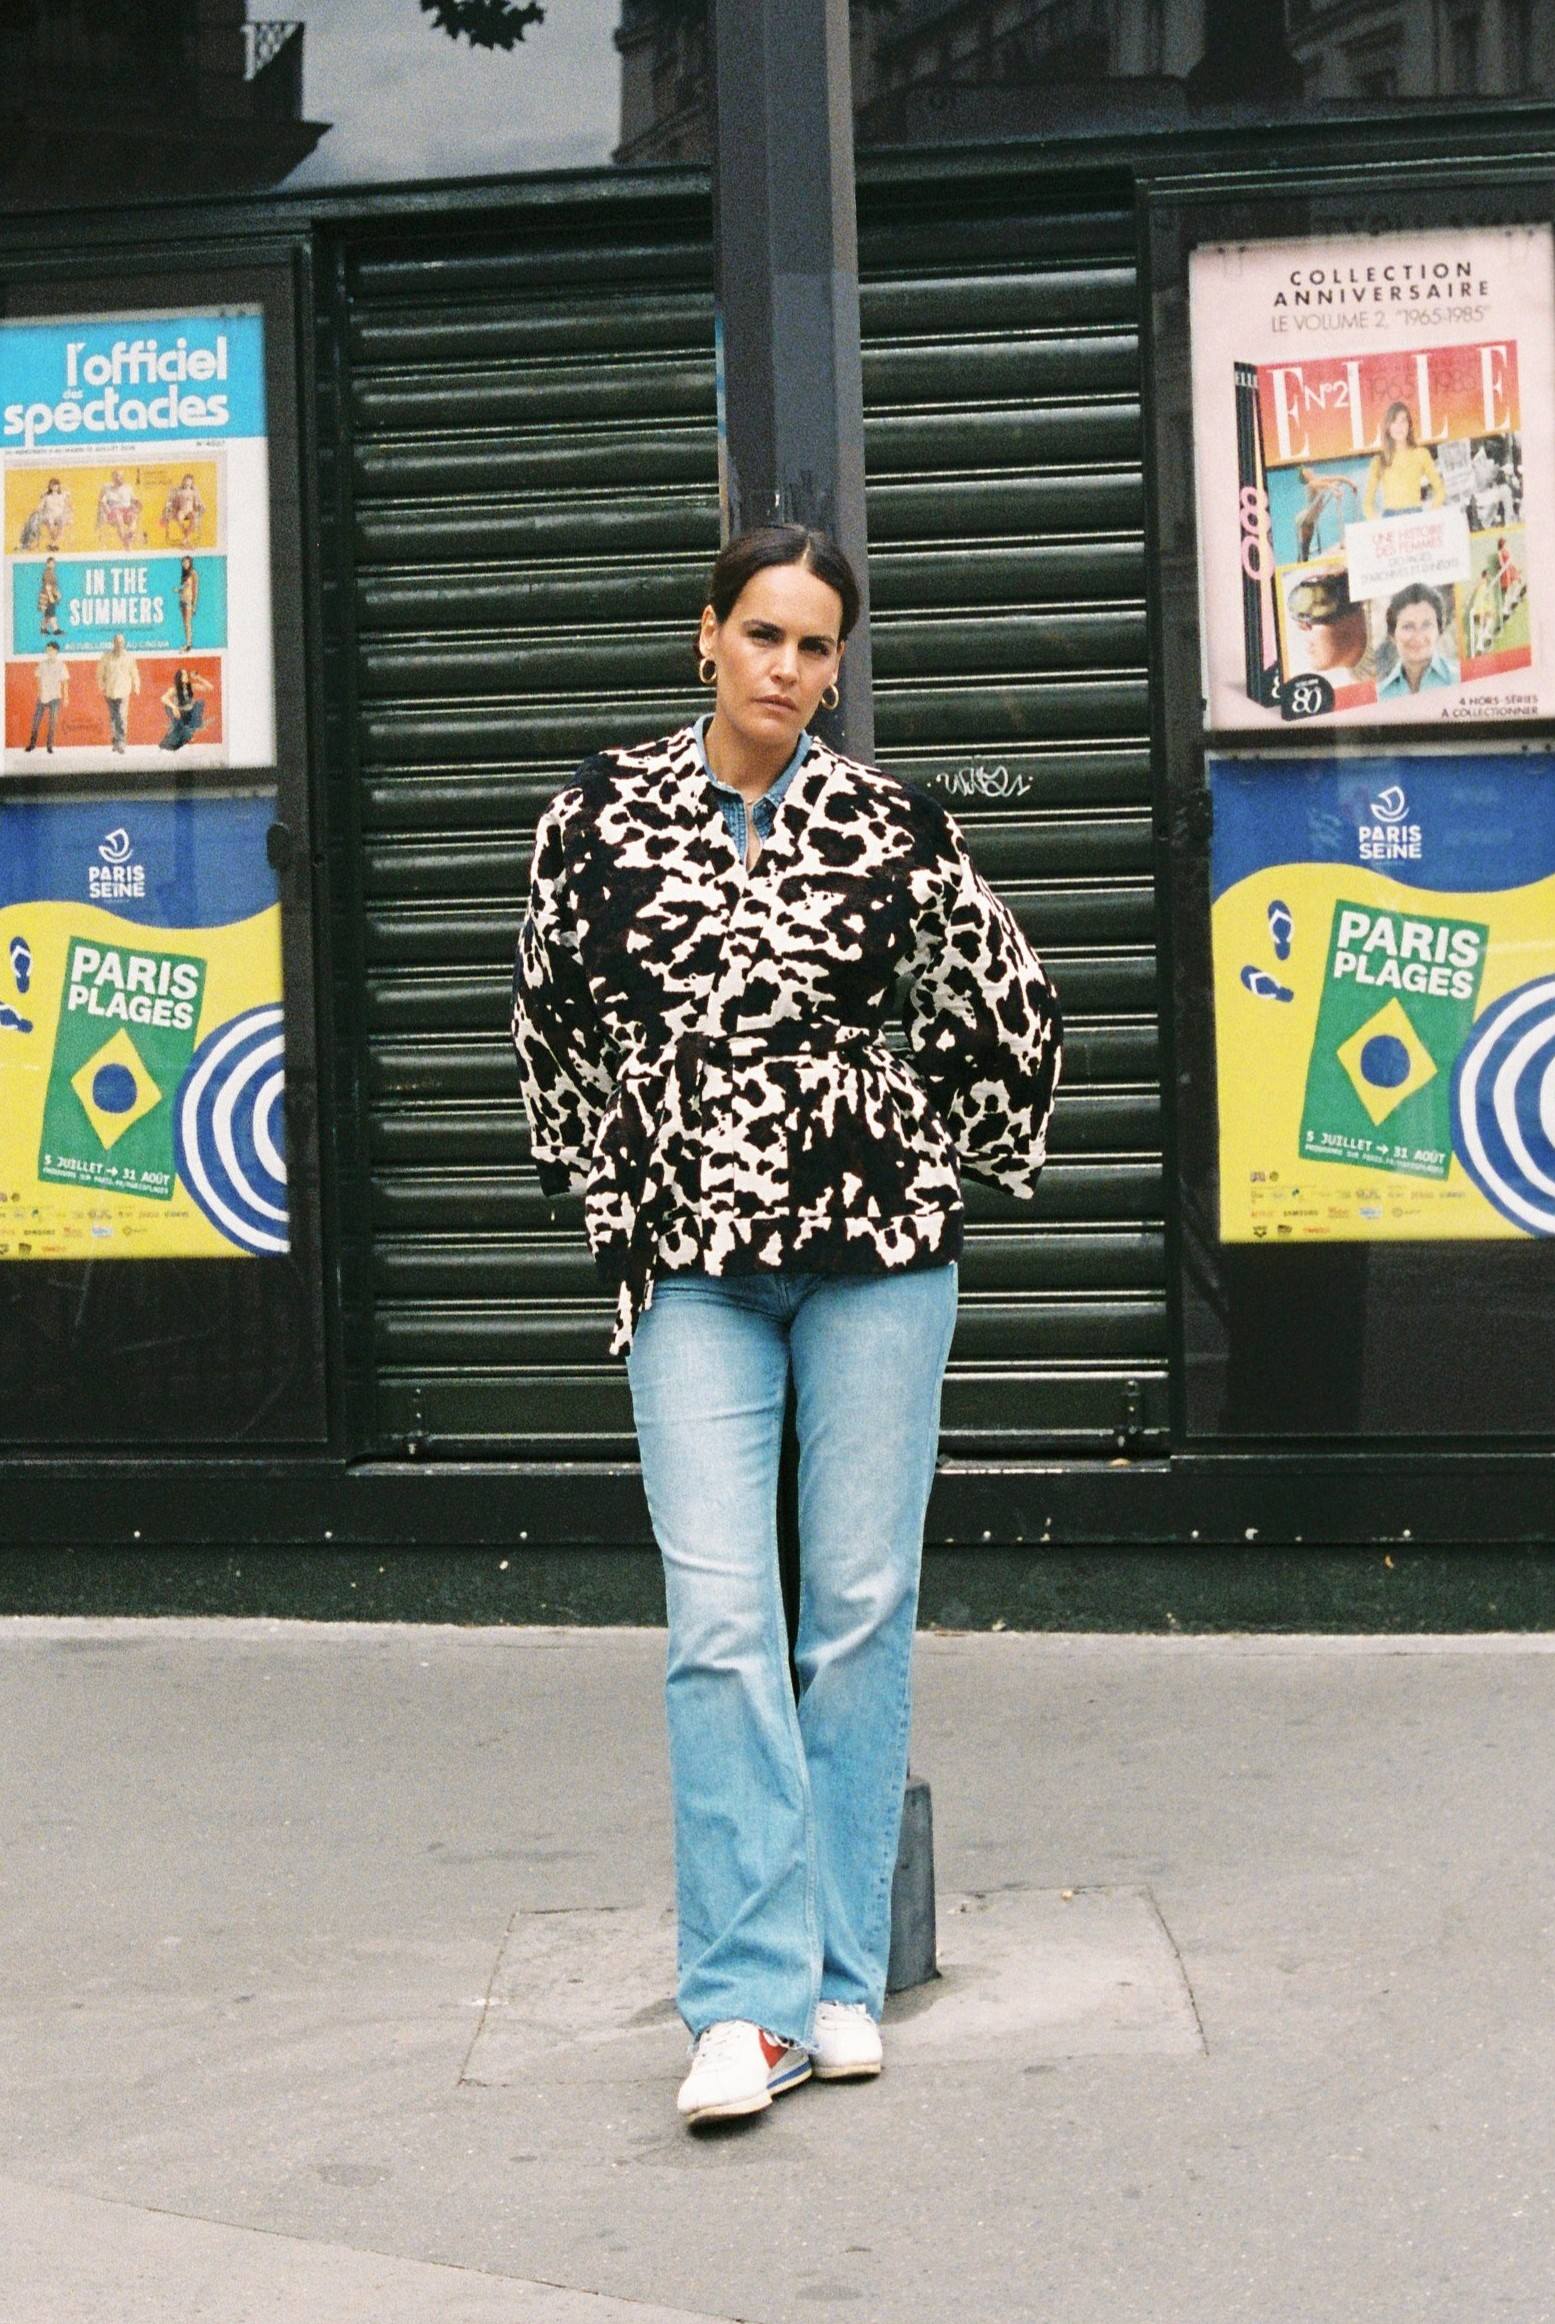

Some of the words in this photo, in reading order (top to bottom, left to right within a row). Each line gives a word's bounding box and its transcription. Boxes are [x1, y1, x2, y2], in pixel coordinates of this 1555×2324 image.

[1290, 262, 1471, 286] COLLECTION
[1274, 280, 1489, 307] ANNIVERSAIRE
[1272, 315, 1289, 333] LE
[1293, 311, 1369, 331] VOLUME
[66, 335, 228, 386] l'officiel
[4, 383, 229, 449] spectacles
[1266, 344, 1511, 460] ELLE
[86, 569, 105, 595] IN
[110, 567, 148, 595] THE
[70, 596, 164, 626] SUMMERS
[1292, 686, 1322, 714] 80
[1359, 824, 1422, 842] PARIS
[1359, 842, 1422, 859] SEINE
[88, 865, 145, 882] PARIS
[89, 882, 146, 899] SEINE
[1337, 910, 1480, 968] PARIS
[71, 946, 199, 1000] PARIS
[1333, 950, 1474, 999] PLAGES
[68, 984, 194, 1030] PLAGES
[1306, 1130, 1314, 1142] 5
[1321, 1132, 1372, 1151] JUILLET
[1393, 1146, 1407, 1159] 31
[44, 1154, 52, 1166] 5
[57, 1156, 103, 1174] JUILLET
[122, 1168, 136, 1180] 31
